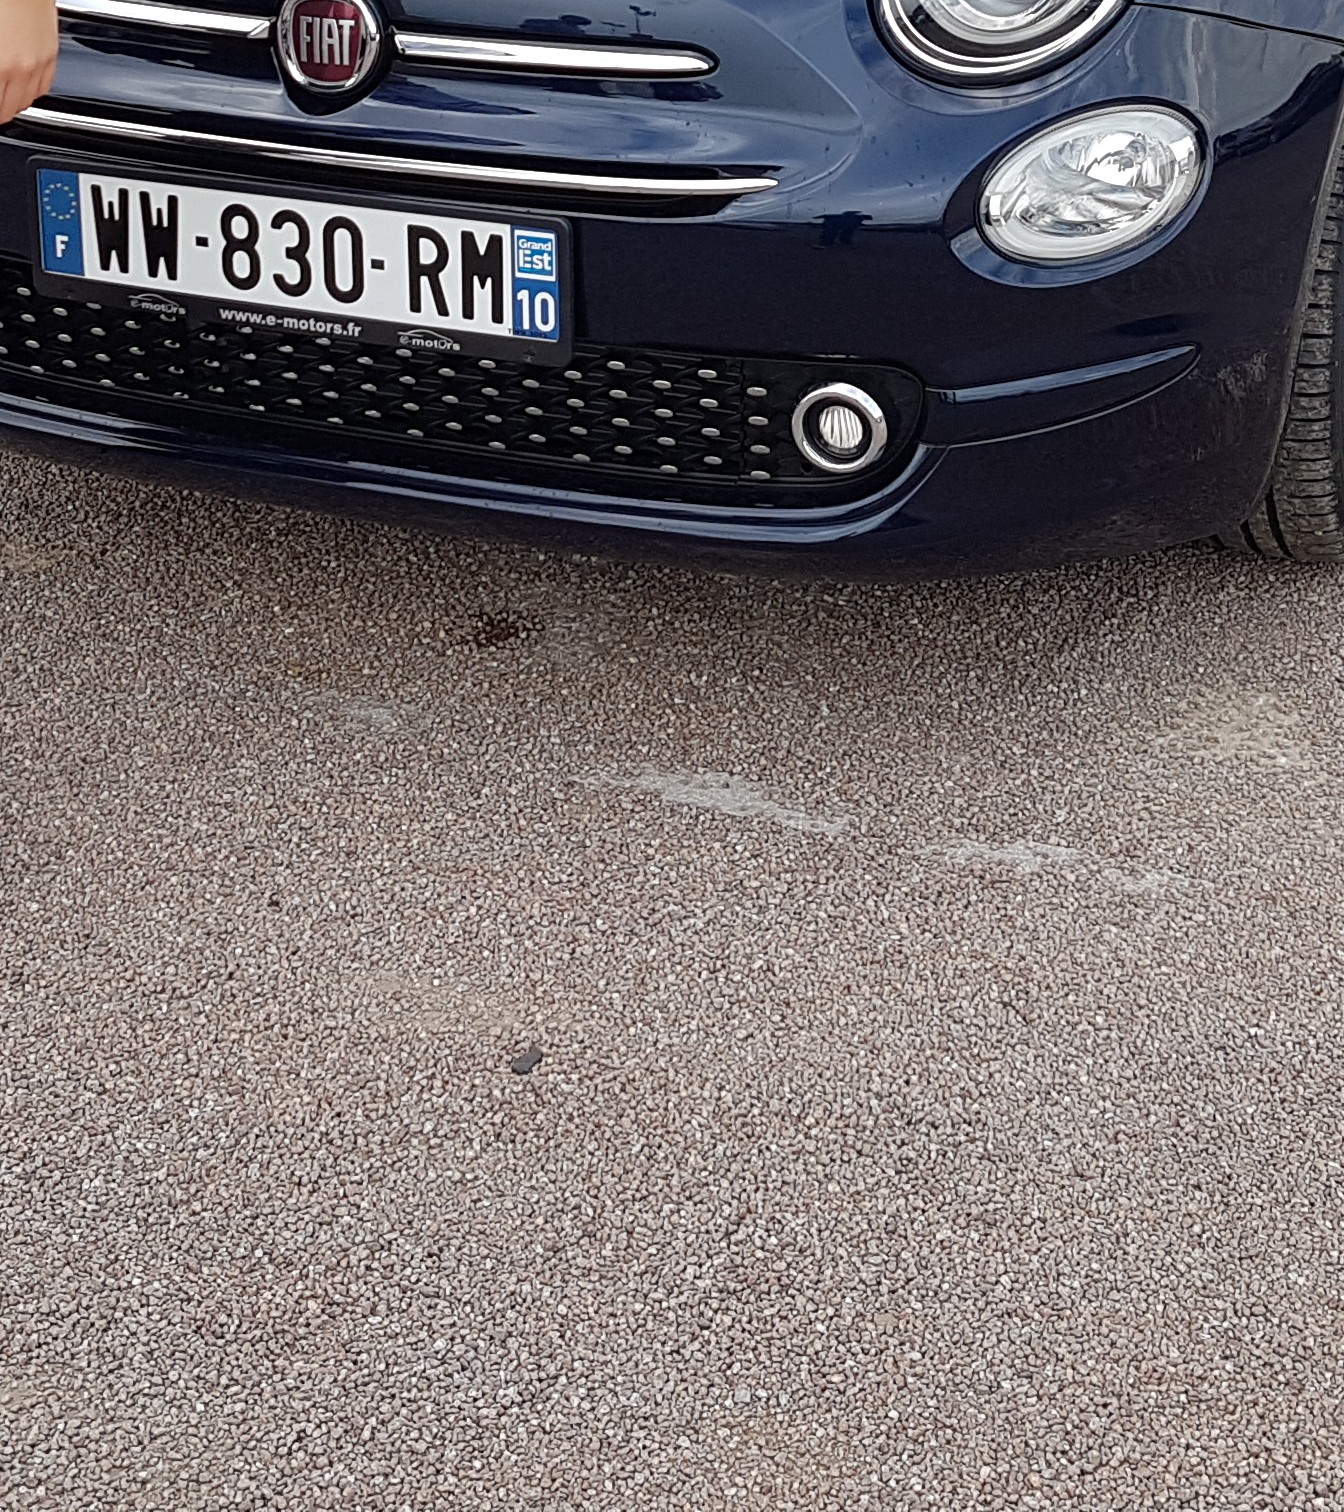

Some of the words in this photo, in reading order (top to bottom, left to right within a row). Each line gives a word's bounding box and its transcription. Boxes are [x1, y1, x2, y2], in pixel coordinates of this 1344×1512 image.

[299, 15, 355, 66] FIAT
[55, 234, 69, 258] F
[90, 183, 504, 325] WW-830-RM
[518, 238, 552, 251] Grand
[518, 249, 552, 271] Est
[219, 308, 362, 337] www.e-motors.fr
[517, 289, 555, 332] 10
